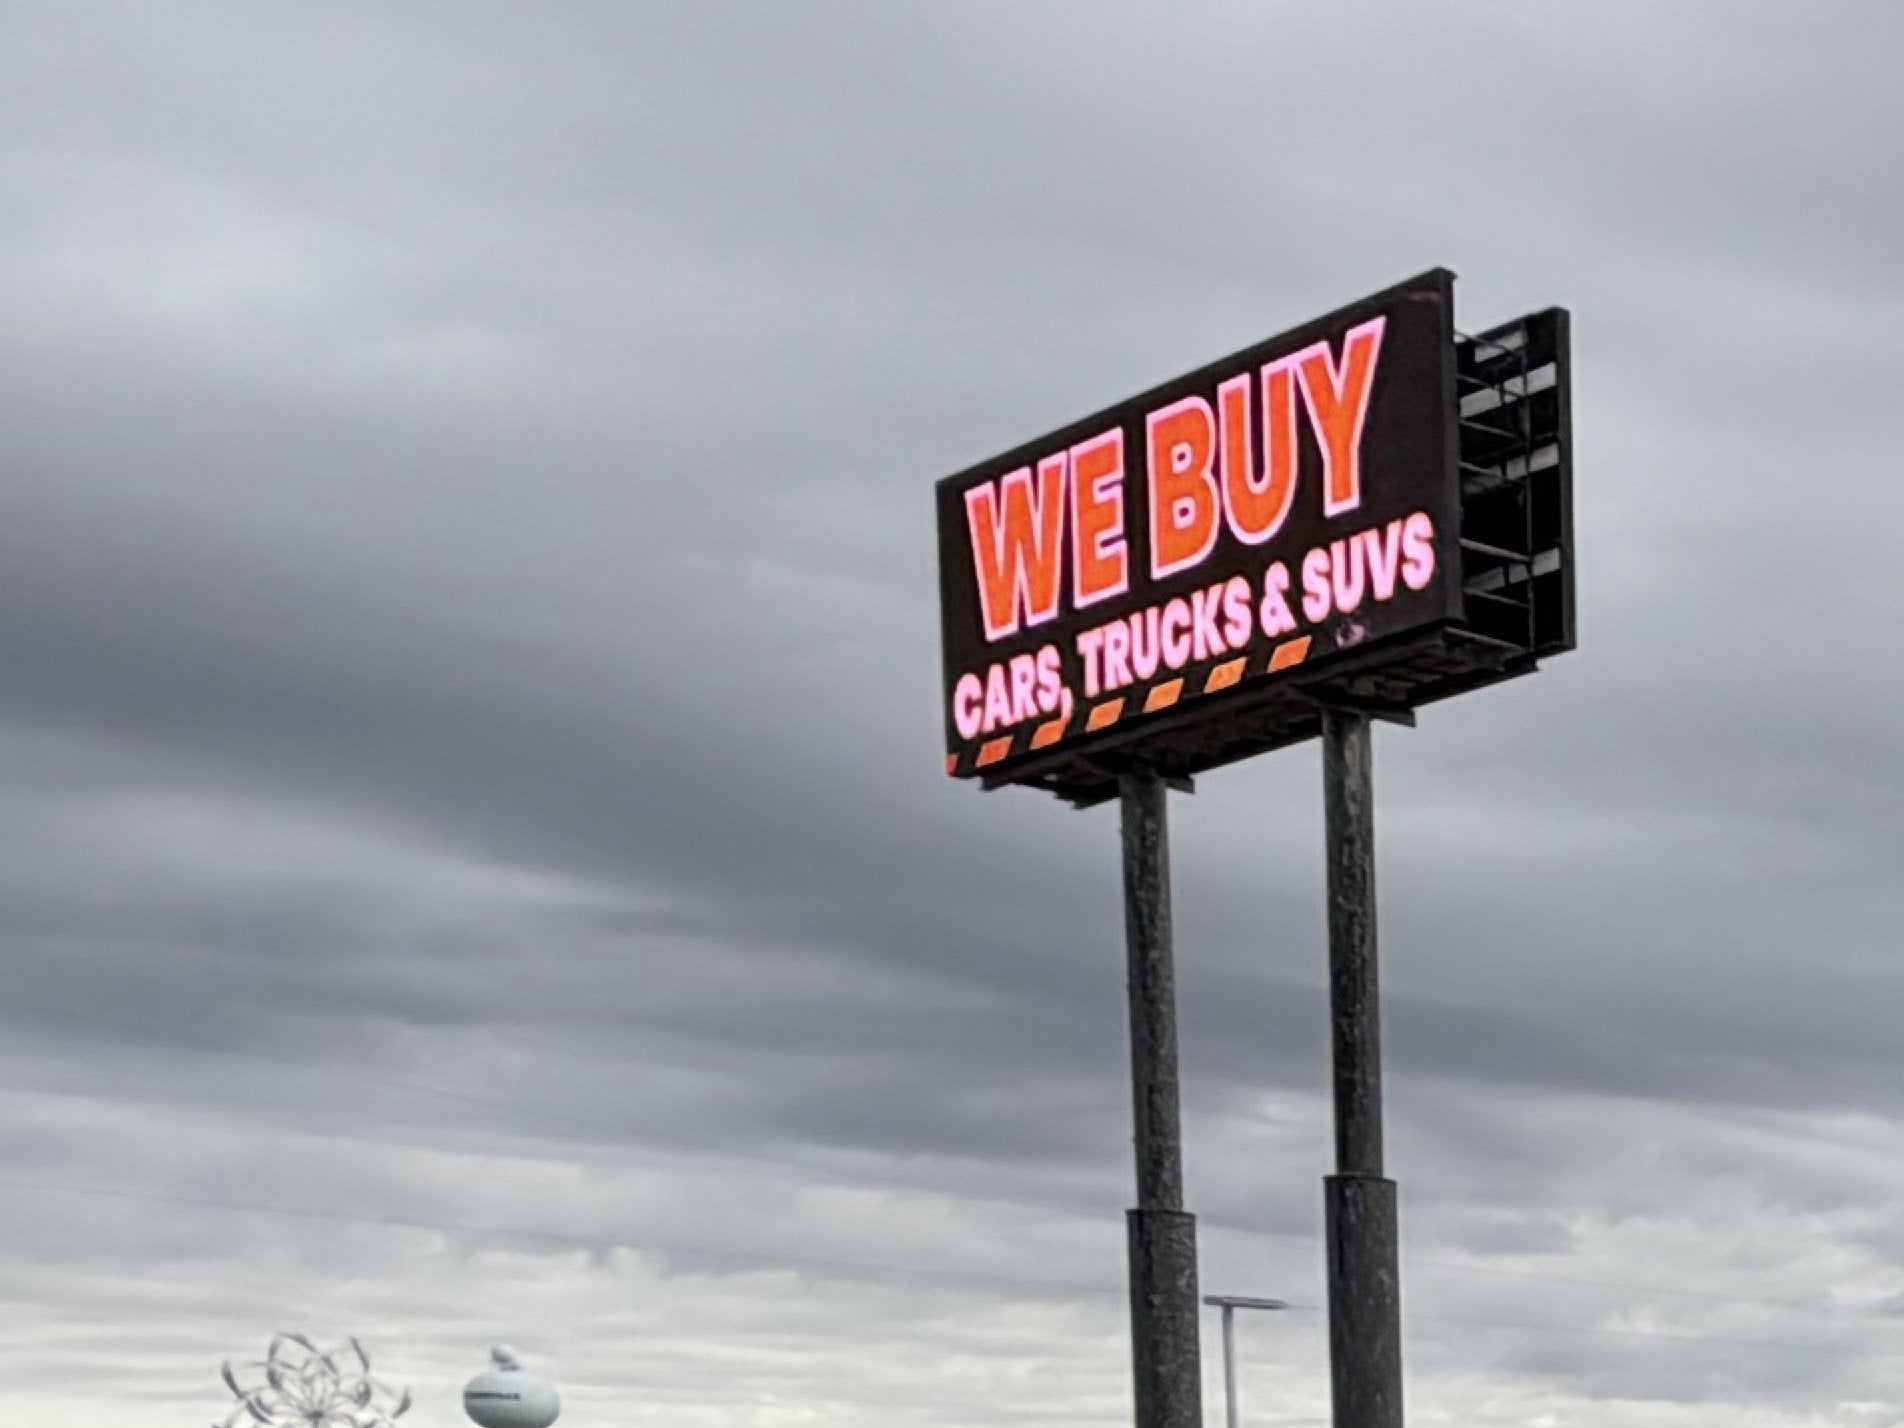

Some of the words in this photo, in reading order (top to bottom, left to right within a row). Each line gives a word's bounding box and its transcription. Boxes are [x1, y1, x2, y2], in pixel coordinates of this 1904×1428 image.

[964, 426, 1130, 641] WE
[1146, 314, 1388, 580] BUY
[953, 645, 1074, 741] CARS,
[1076, 575, 1252, 696] TRUCKS
[1259, 560, 1298, 632] &
[1301, 511, 1436, 624] SUVS
